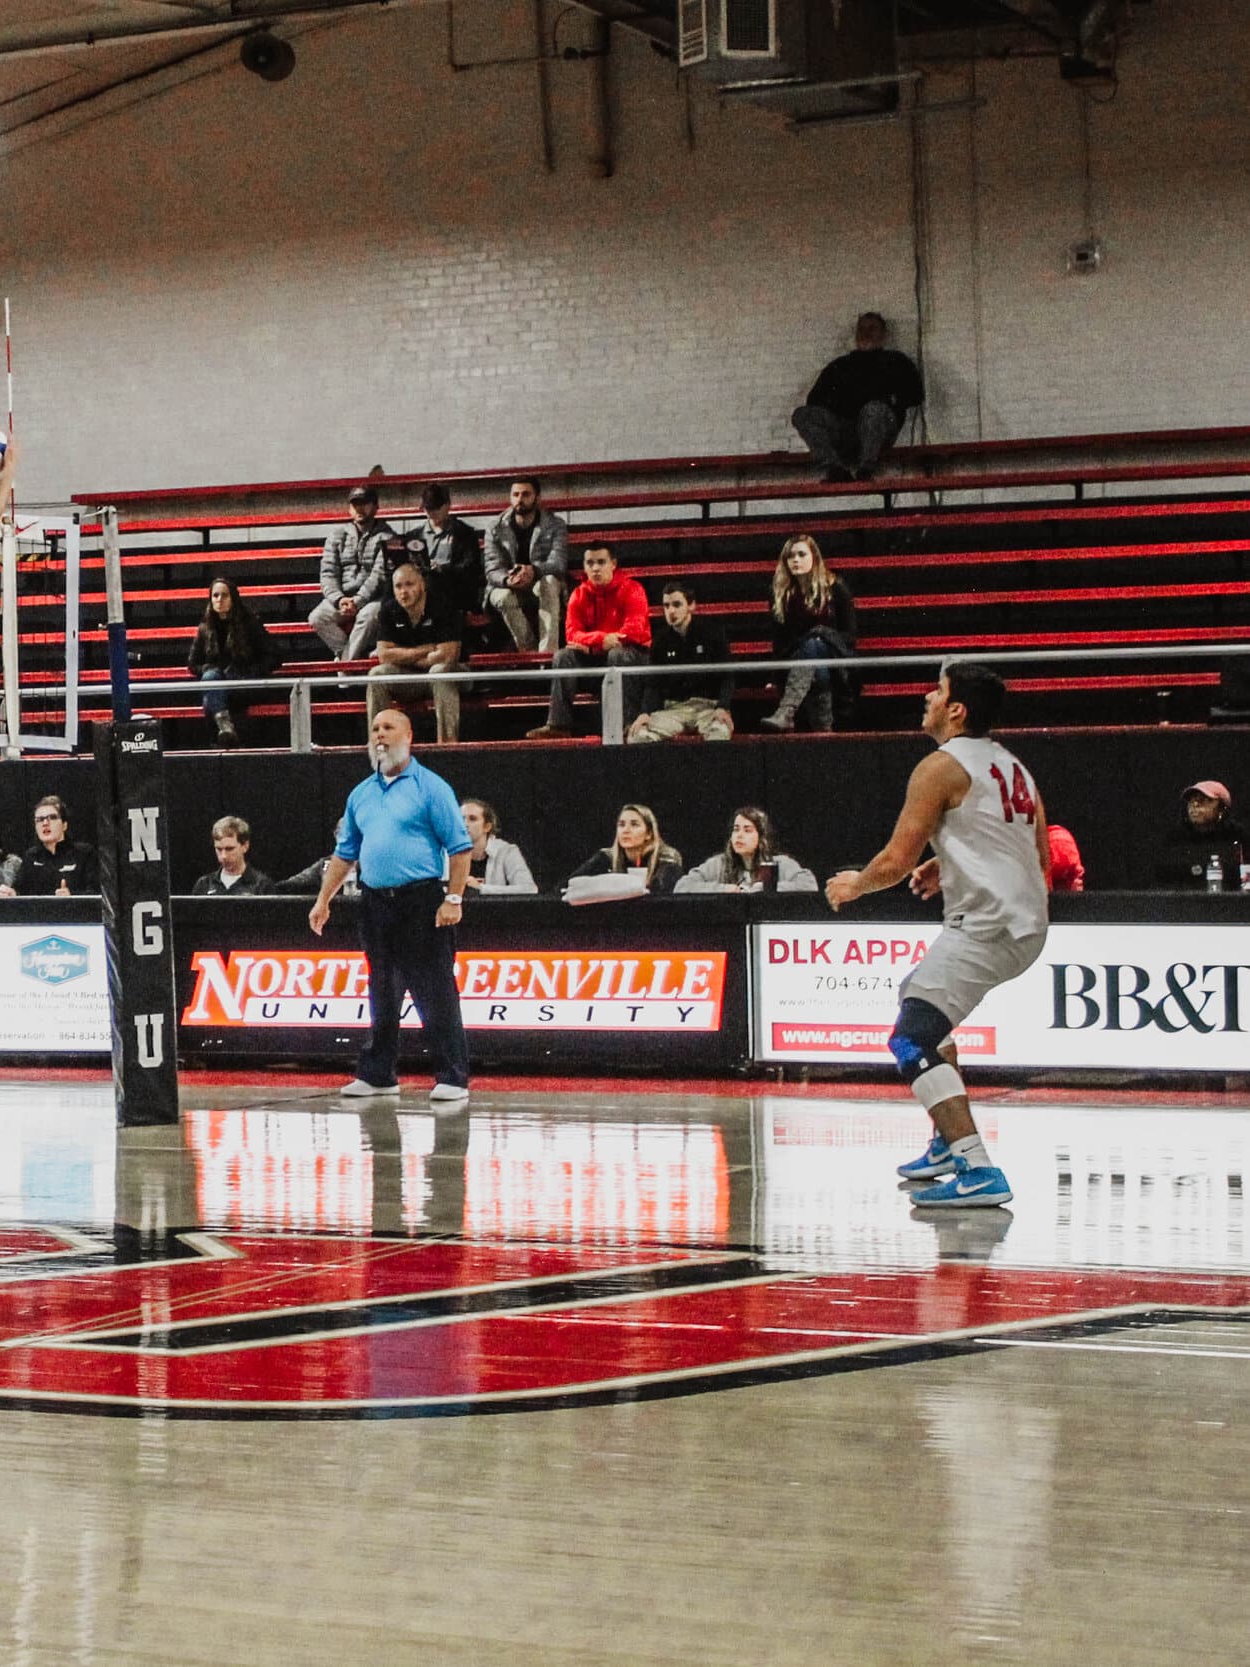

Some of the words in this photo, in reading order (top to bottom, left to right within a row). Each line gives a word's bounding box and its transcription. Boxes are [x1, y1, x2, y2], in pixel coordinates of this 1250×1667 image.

[989, 762, 1035, 825] 14
[768, 938, 832, 965] DLK
[188, 956, 371, 1020] NORTH
[453, 958, 714, 999] EENVILLE
[262, 1002, 694, 1023] UNIRSITY
[1046, 962, 1250, 1034] BB&T
